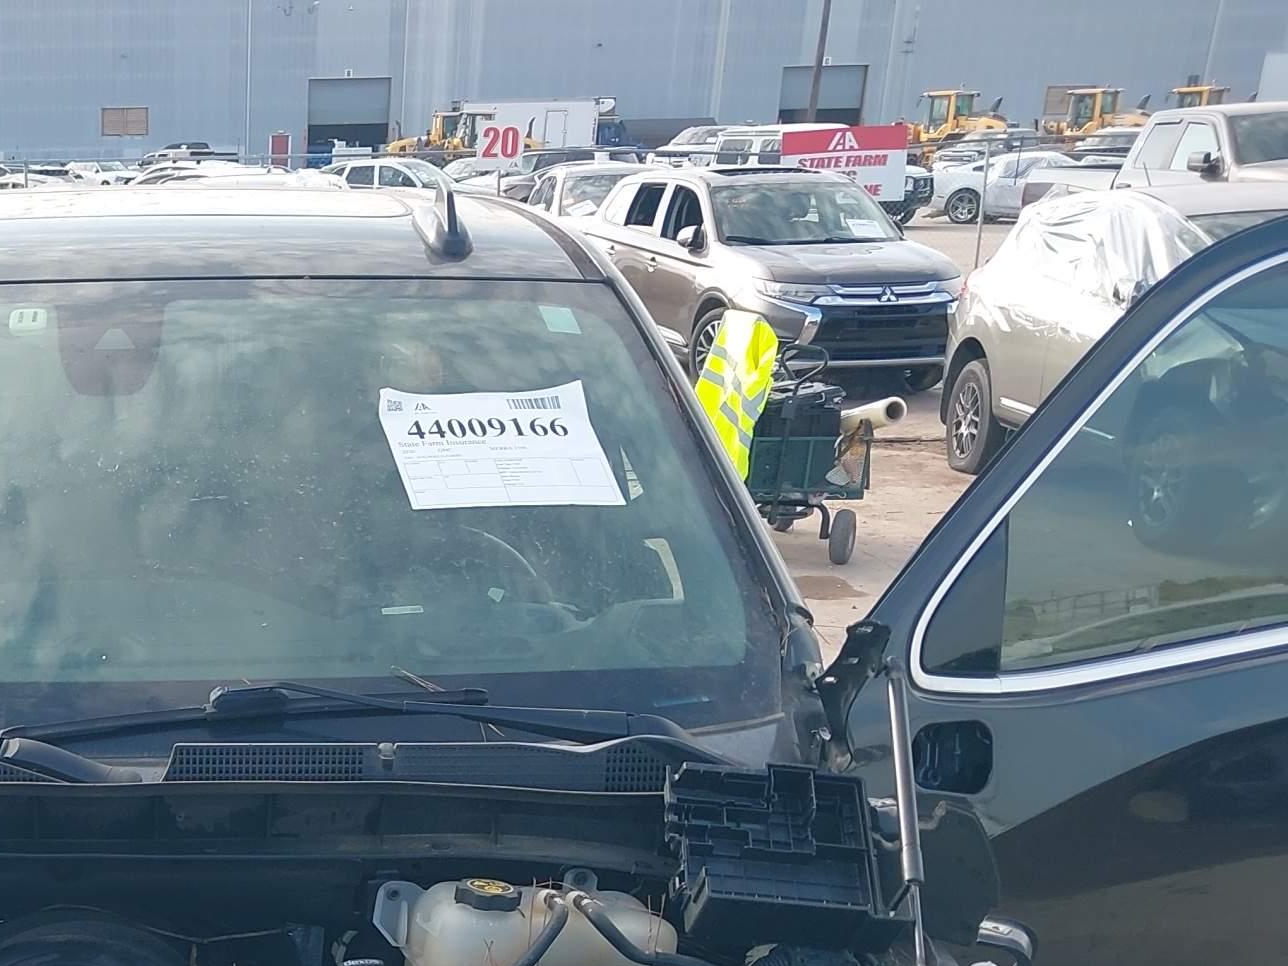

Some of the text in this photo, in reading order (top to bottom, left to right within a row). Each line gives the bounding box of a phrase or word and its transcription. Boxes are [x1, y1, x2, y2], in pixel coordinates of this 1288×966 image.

[482, 127, 519, 158] 20
[797, 154, 888, 169] STATE FARM
[407, 417, 569, 439] 44009166
[445, 438, 487, 446] Insurance
